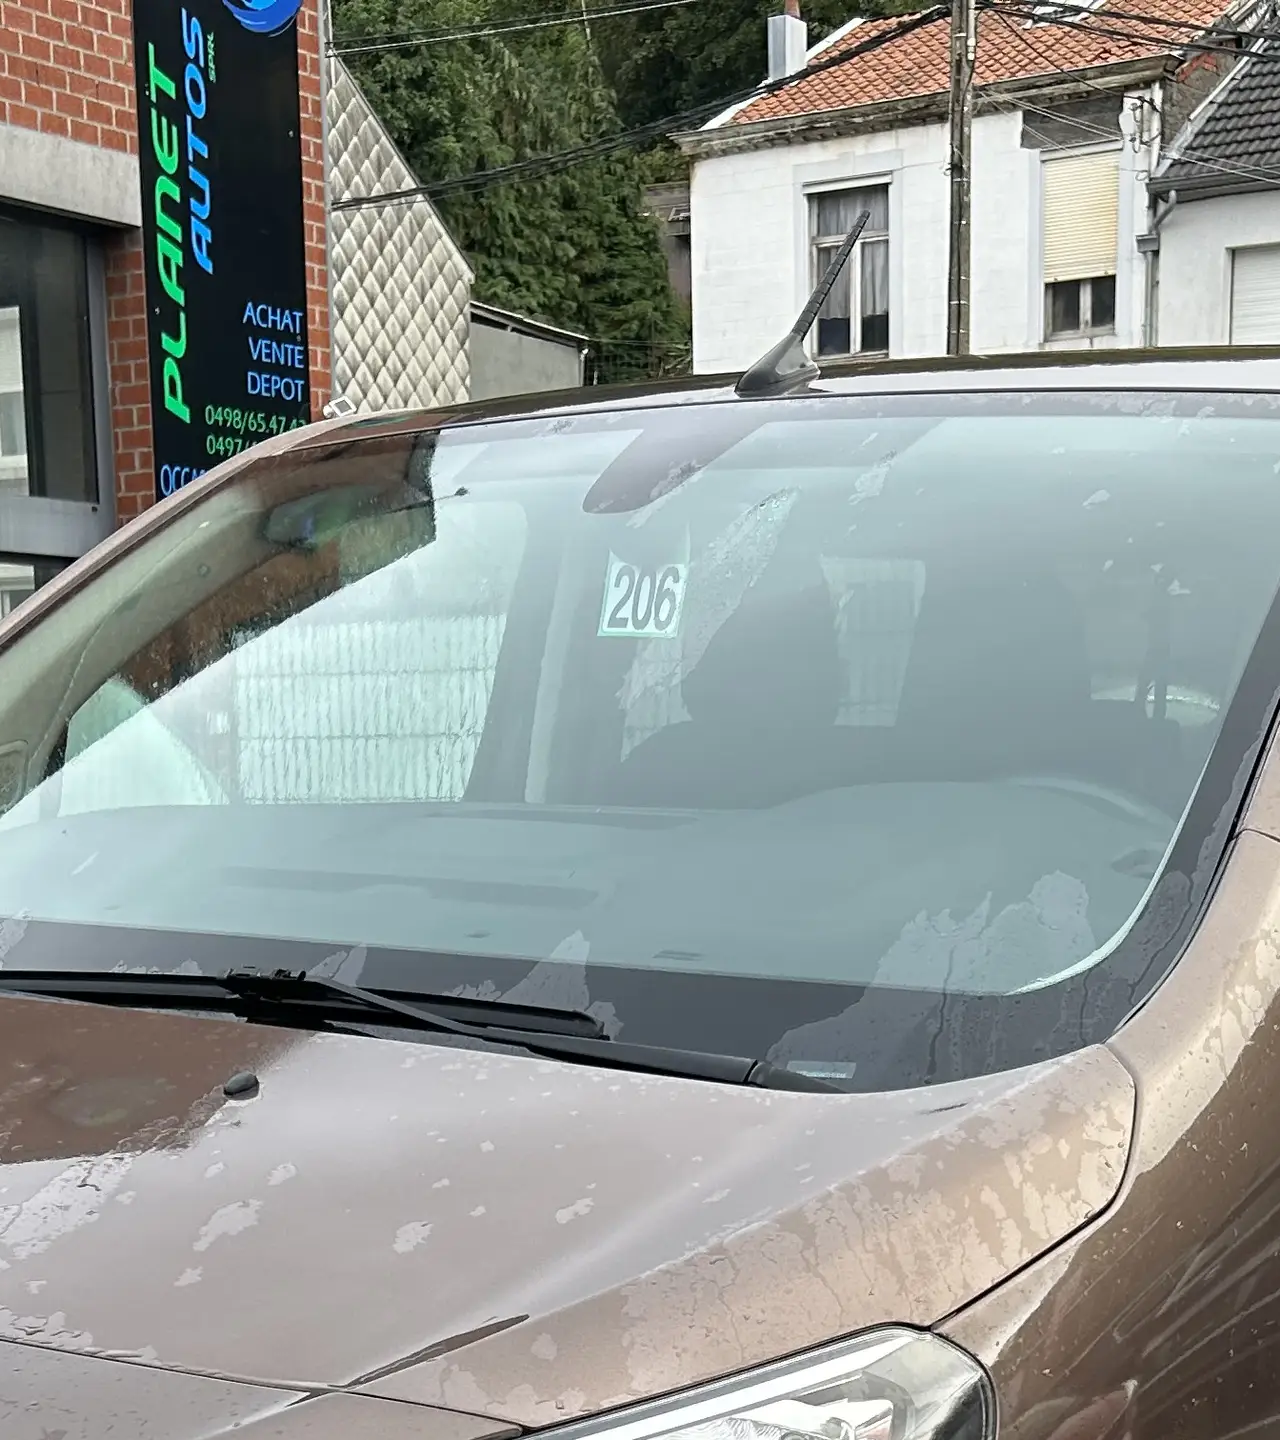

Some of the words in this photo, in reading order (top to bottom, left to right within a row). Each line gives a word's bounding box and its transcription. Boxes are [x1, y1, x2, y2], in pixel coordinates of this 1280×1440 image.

[181, 8, 213, 275] AUTOS
[148, 42, 191, 424] PLANET
[243, 302, 303, 335] ACHAT
[248, 336, 305, 369] VENTE
[247, 371, 305, 403] DEPOT
[606, 565, 680, 632] 206
